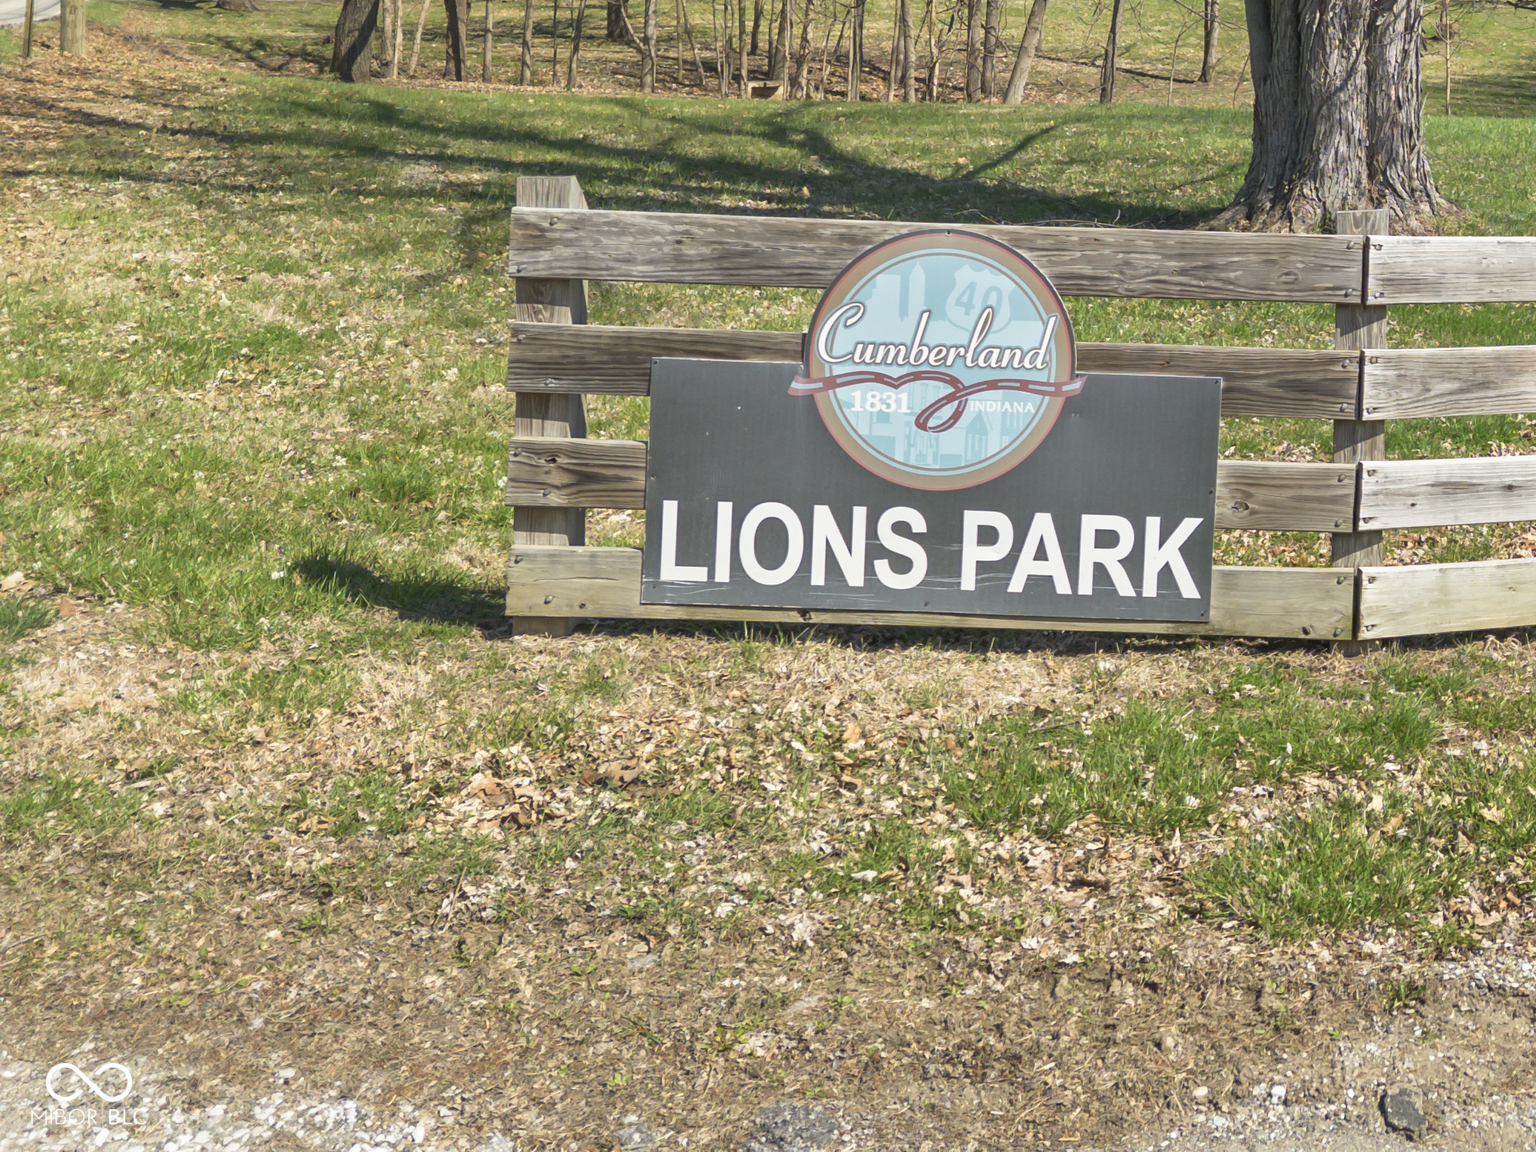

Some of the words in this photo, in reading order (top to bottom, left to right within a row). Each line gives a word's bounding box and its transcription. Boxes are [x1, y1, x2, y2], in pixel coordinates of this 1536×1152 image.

[954, 281, 1004, 320] 40
[818, 303, 1057, 370] Cumberland
[850, 390, 911, 413] 1831
[969, 400, 1035, 413] INDIANA
[659, 499, 928, 590] LIONS
[960, 509, 1204, 599] PARK
